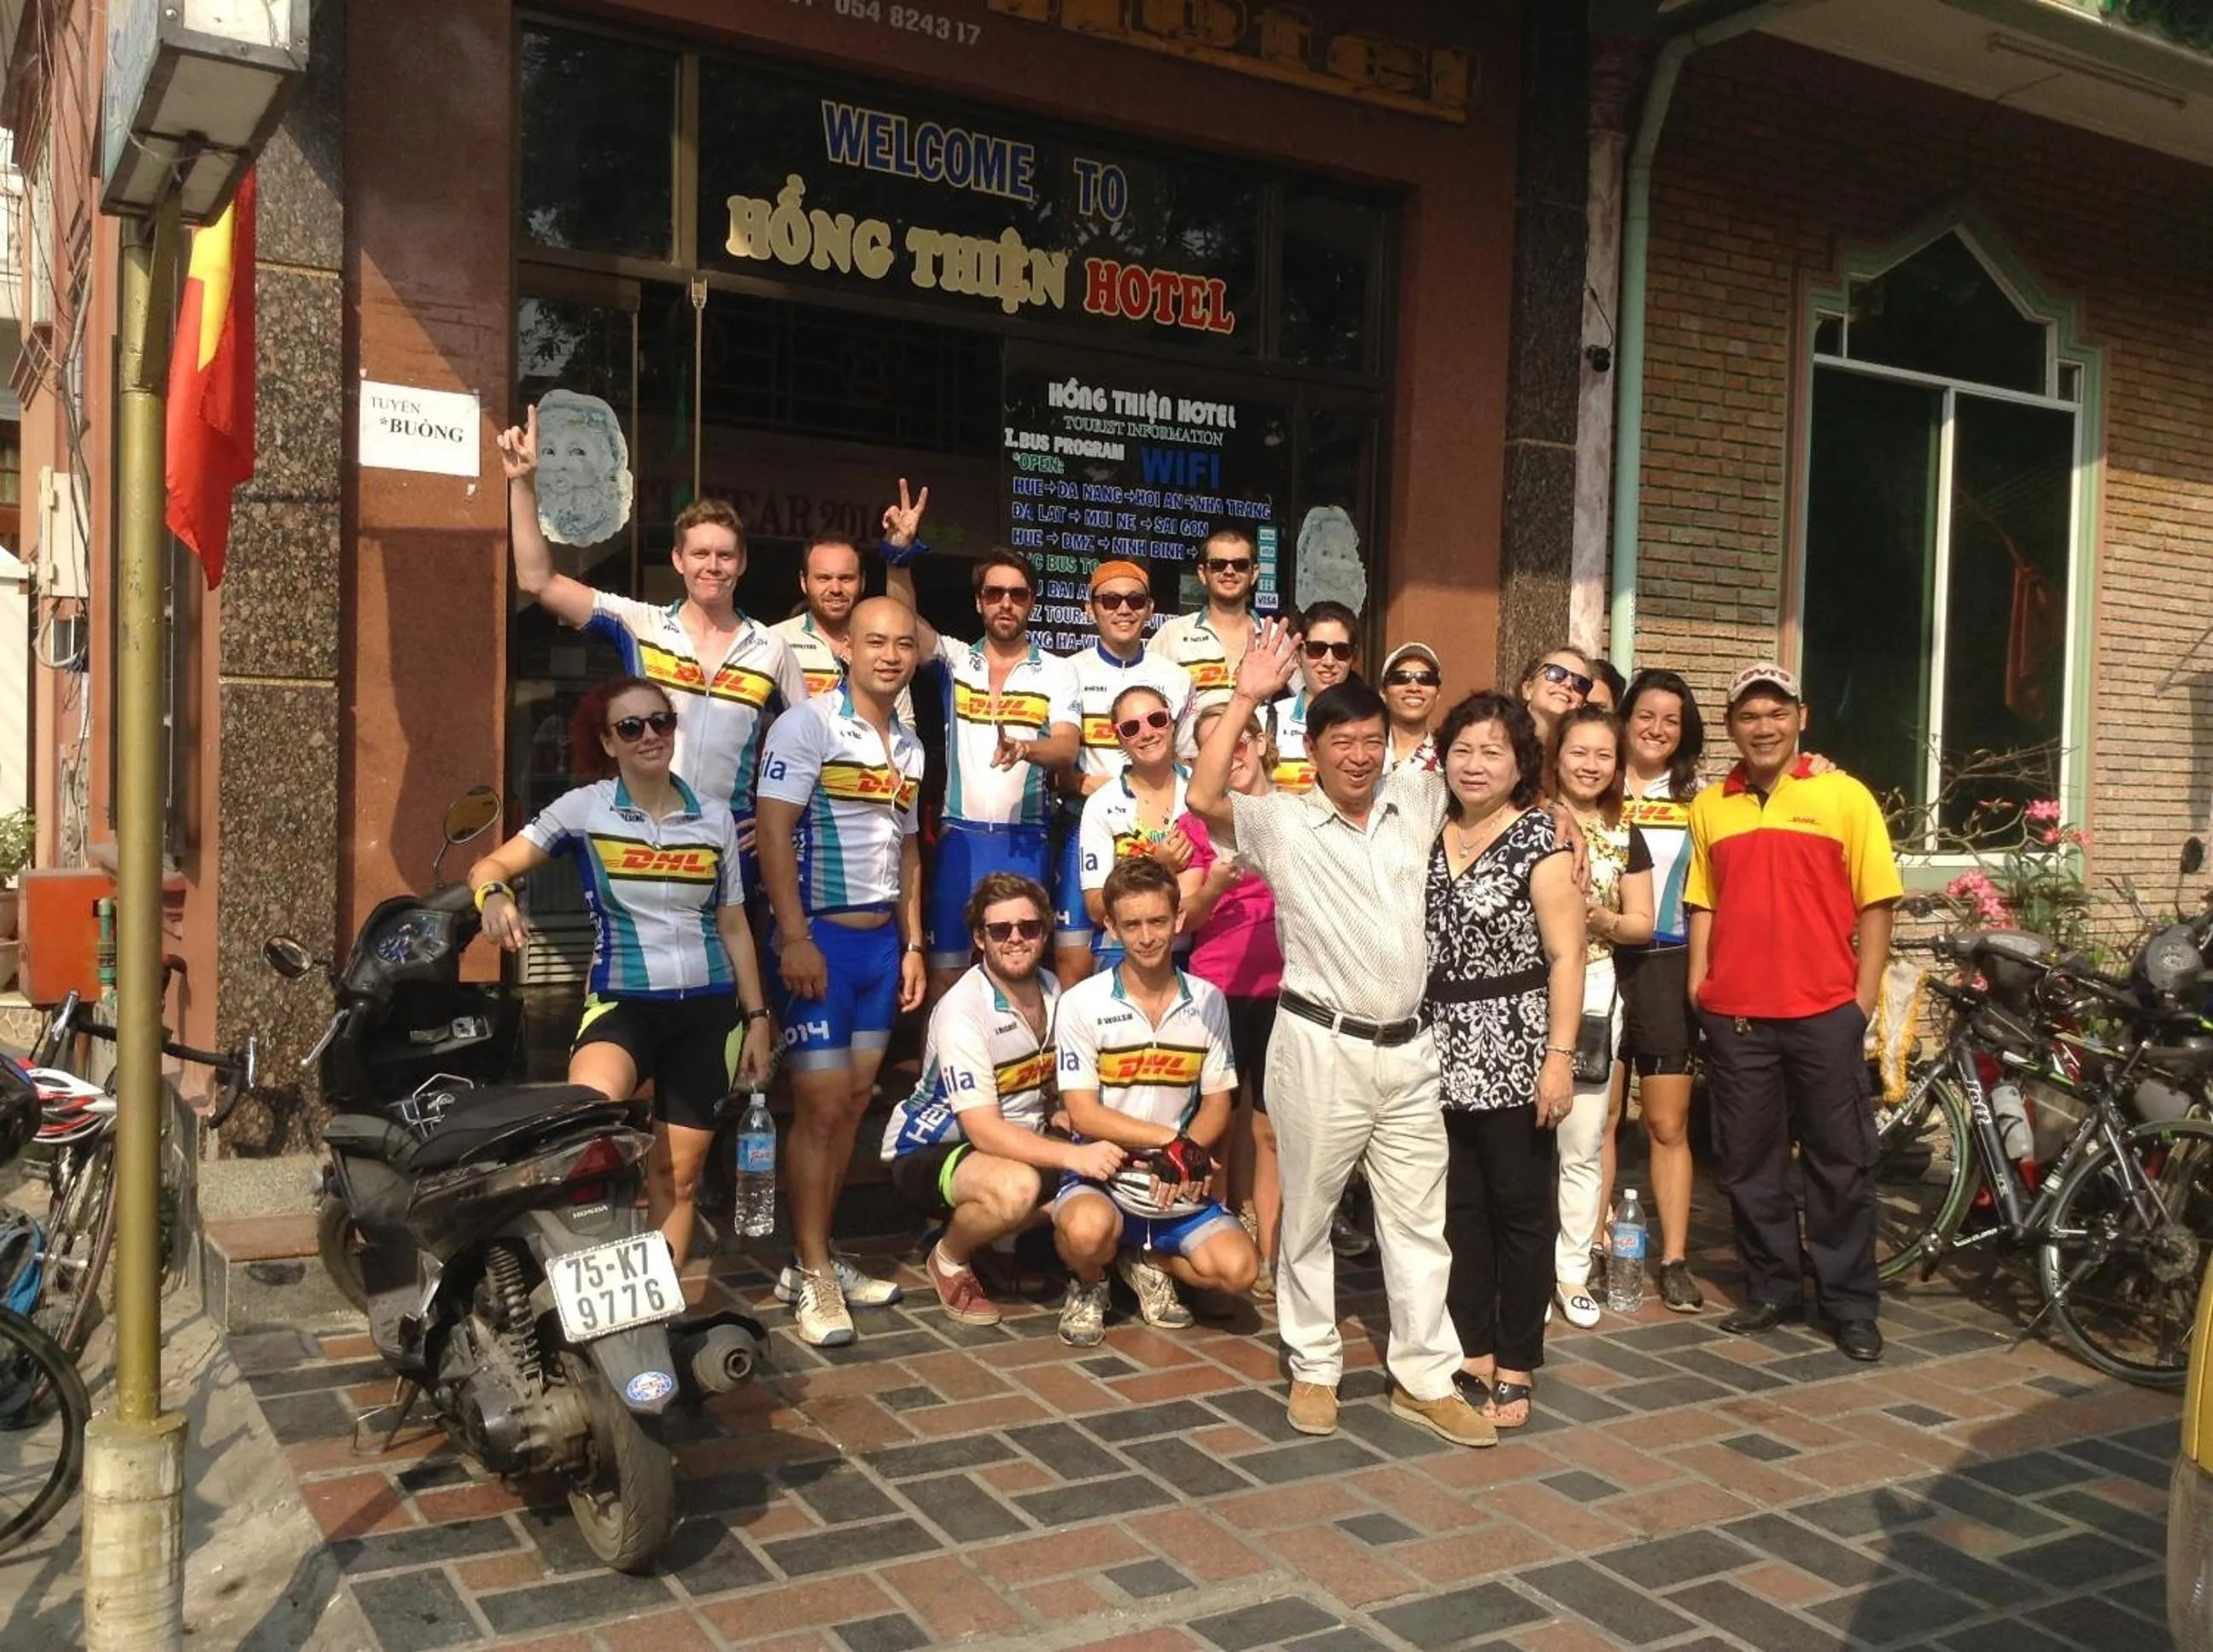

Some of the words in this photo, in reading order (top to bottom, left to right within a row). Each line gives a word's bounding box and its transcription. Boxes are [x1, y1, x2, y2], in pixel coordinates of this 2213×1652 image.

[821, 100, 1035, 202] WELCOME
[1073, 157, 1128, 221] TO
[1084, 258, 1235, 334] HOTEL
[1177, 399, 1236, 429] HOTEL
[1063, 415, 1124, 435] TOURIST
[1127, 422, 1224, 447] INFORMATION
[1054, 436, 1124, 460] PROGRAM
[1013, 476, 1043, 496] HUE
[1082, 483, 1123, 504] NANG
[1163, 492, 1183, 511] AN
[1226, 499, 1270, 520] TRANG
[1153, 516, 1177, 534] SAI
[1180, 518, 1209, 536] GON
[1012, 528, 1043, 546] HUE
[1061, 532, 1095, 552] DMZ
[1112, 536, 1147, 556] NINH
[1150, 541, 1185, 560] BINH
[1047, 554, 1077, 573] BUS
[1258, 597, 1277, 606] VISA
[622, 848, 705, 873] DHL
[785, 1019, 830, 1045] 014
[1118, 1054, 1186, 1077] DHL
[573, 1205, 609, 1219] HONDA
[566, 1241, 649, 1293] 75-K7
[577, 1278, 665, 1331] 9776
